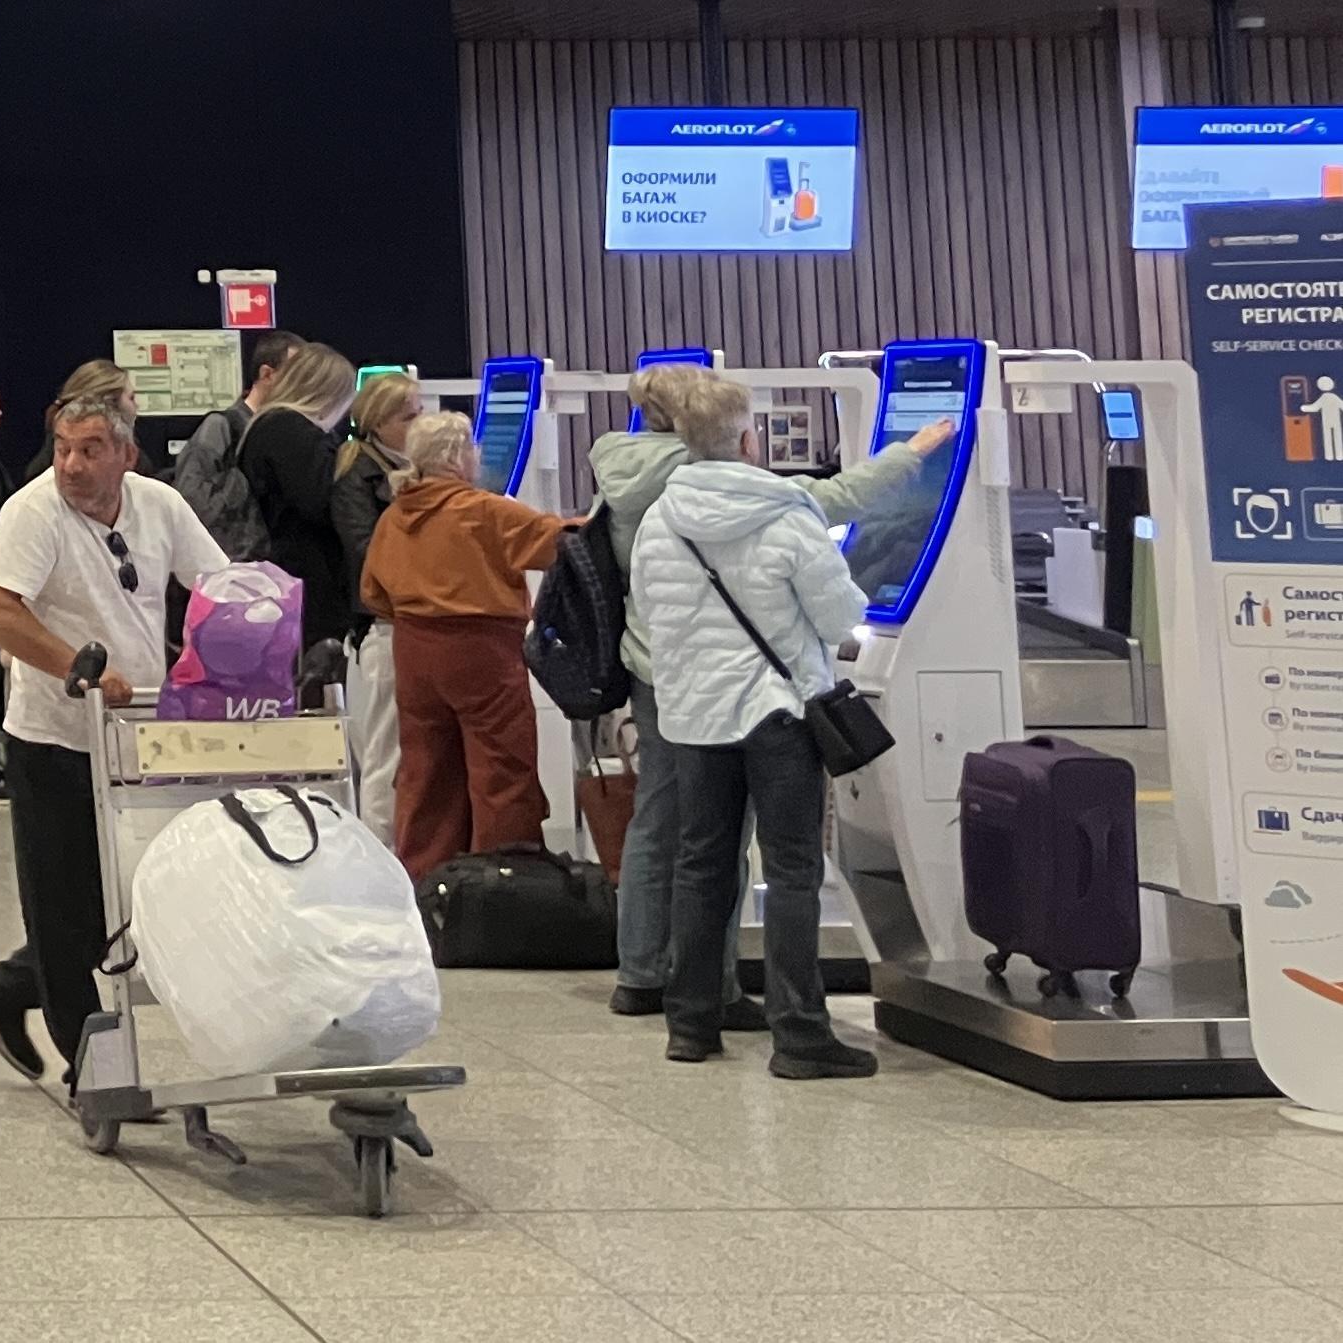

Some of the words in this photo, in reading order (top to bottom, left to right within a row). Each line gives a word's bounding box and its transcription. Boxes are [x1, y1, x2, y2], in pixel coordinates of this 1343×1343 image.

[671, 123, 757, 135] AEROFLOT
[1200, 123, 1287, 134] AEROFLOT
[621, 172, 717, 186] ОФОРМИЛИ
[622, 191, 677, 205] БАГАЖ
[622, 210, 632, 223] В
[636, 210, 708, 224] КИОСКЕ?
